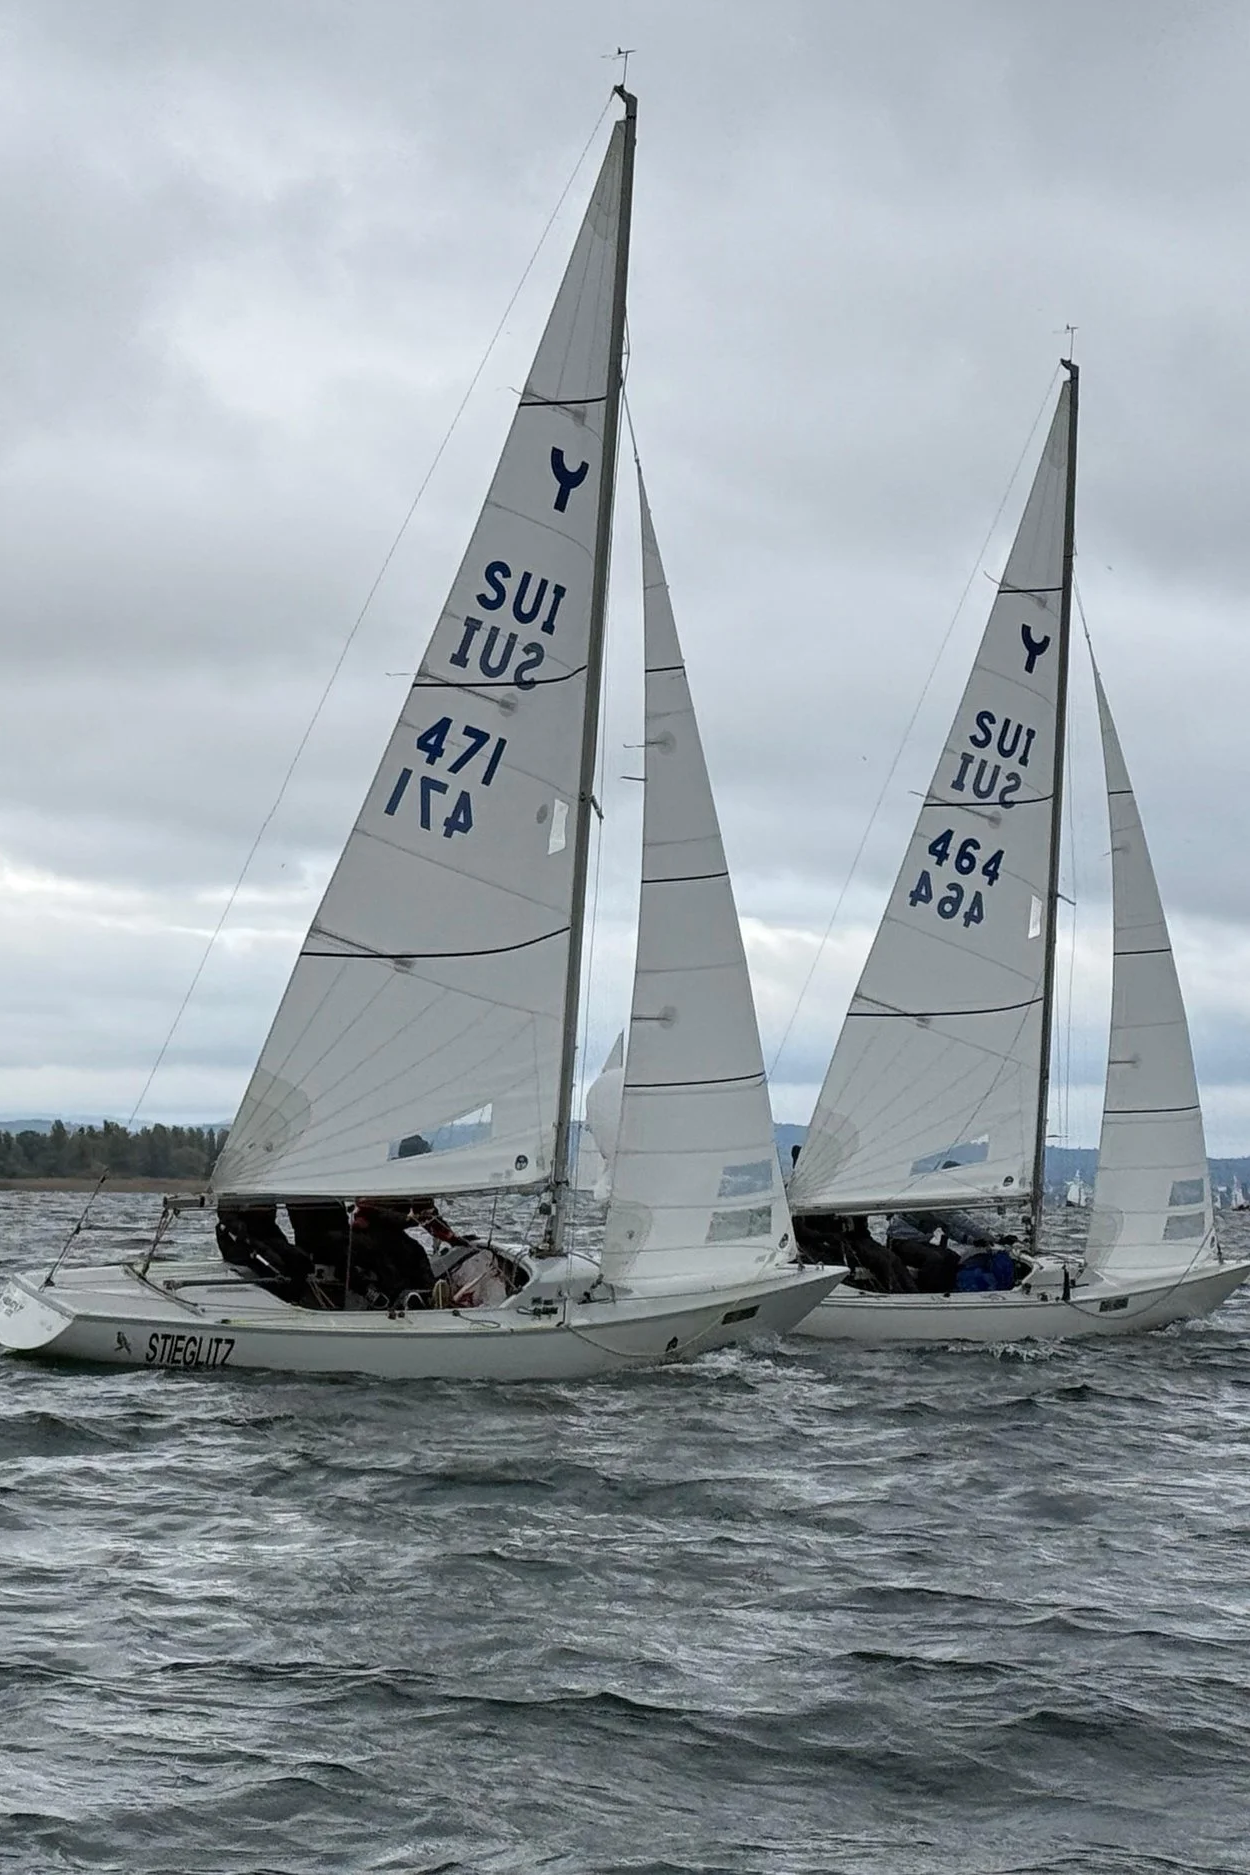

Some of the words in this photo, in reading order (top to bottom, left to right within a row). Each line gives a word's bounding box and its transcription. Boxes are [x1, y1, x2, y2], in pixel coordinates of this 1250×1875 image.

[476, 561, 566, 635] SUI
[417, 717, 507, 786] 471
[969, 711, 1035, 767] SUI
[929, 829, 1004, 886] 464
[145, 1332, 236, 1366] STIEGLITZ
